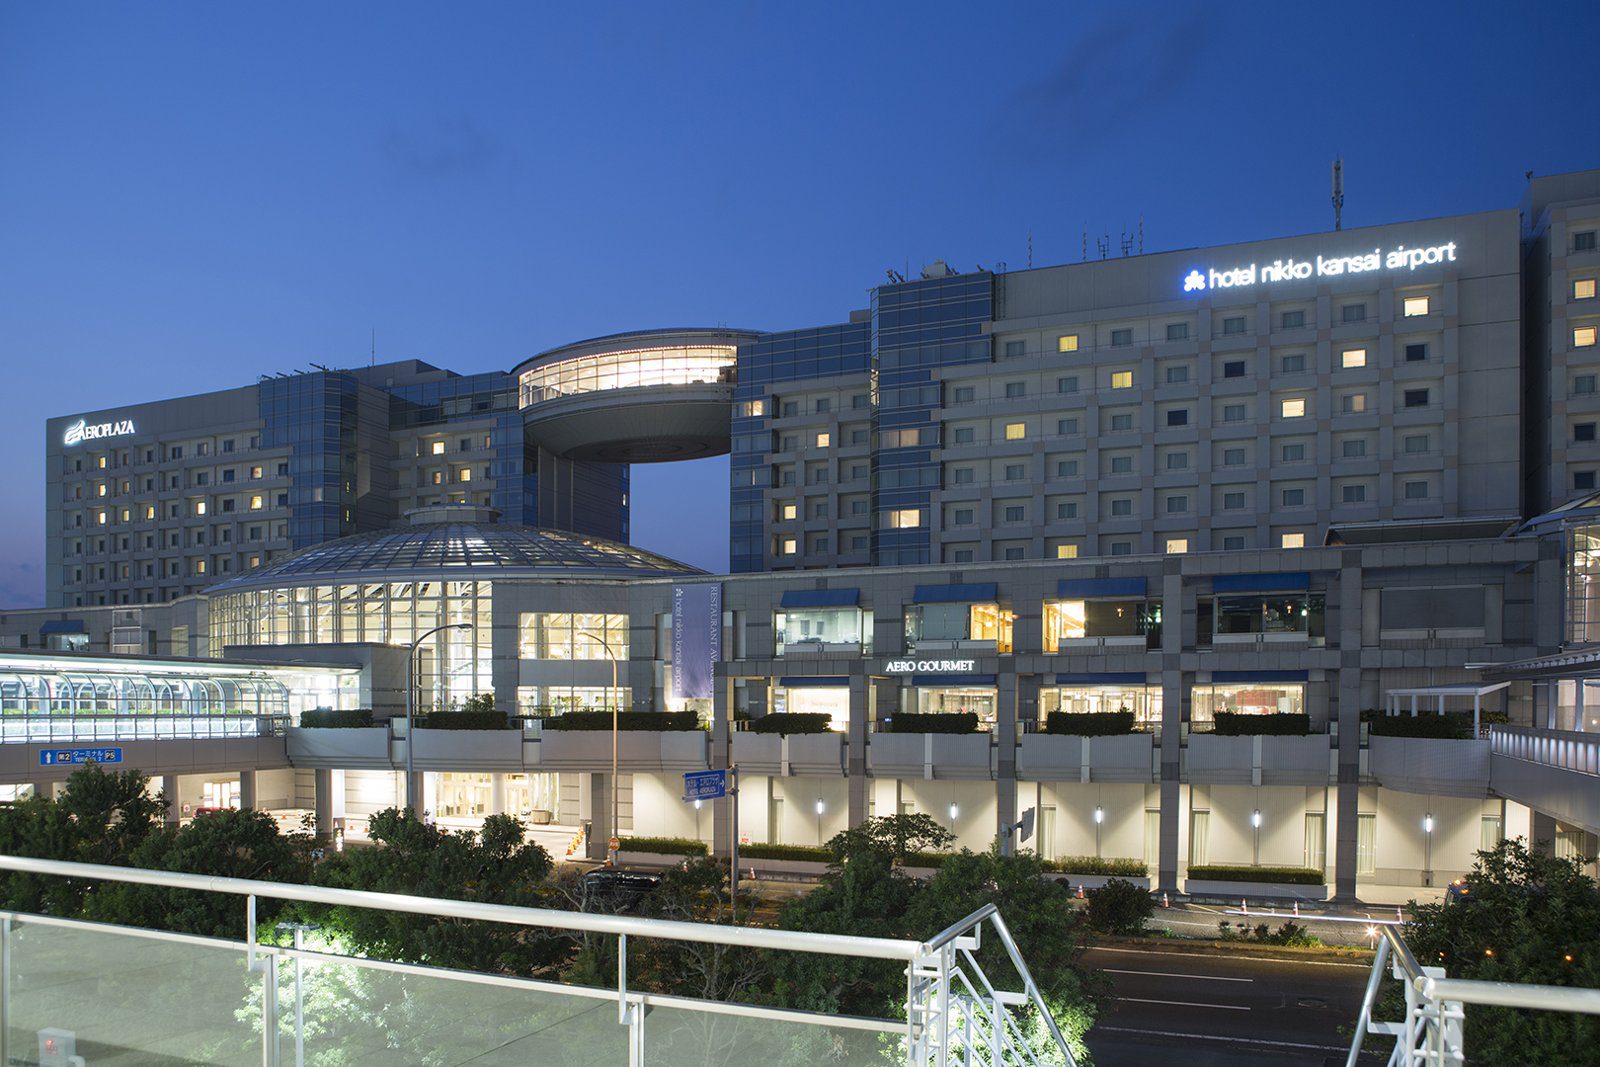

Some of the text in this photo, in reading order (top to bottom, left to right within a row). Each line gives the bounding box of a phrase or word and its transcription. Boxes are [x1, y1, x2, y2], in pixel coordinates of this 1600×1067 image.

[1209, 241, 1456, 289] hotel nikko kansai airport
[78, 419, 135, 440] AEROPLAZA
[675, 598, 683, 616] hotel
[710, 586, 718, 646] RESTAURANT
[675, 618, 683, 638] nikko
[675, 640, 683, 664] kansai
[886, 660, 975, 672] AERO GOURMET
[73, 750, 104, 758] ターミナル
